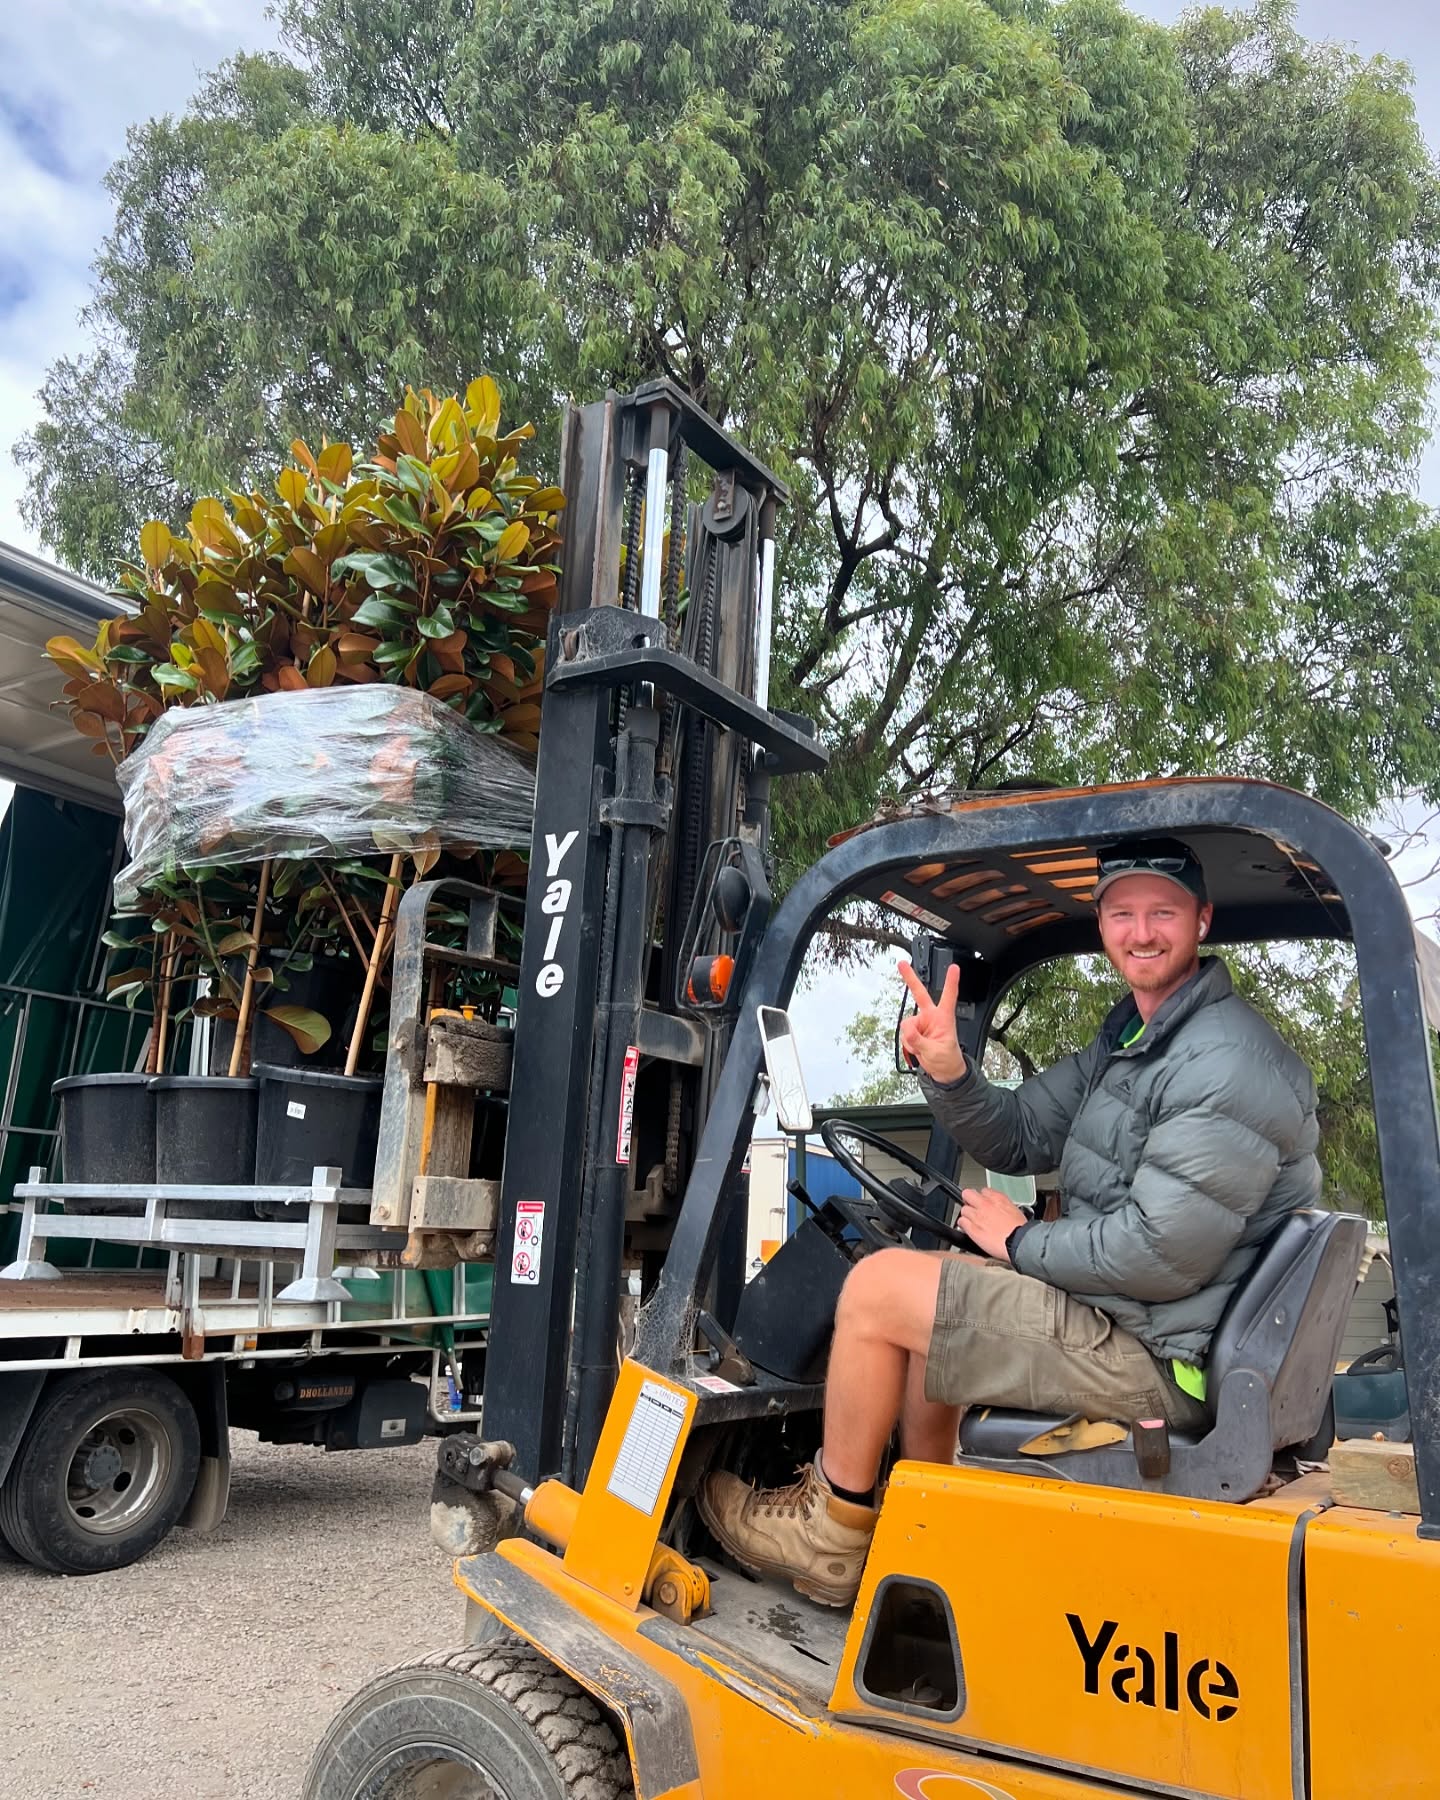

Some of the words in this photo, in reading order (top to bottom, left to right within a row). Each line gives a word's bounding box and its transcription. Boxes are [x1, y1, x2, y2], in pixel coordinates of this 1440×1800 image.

[535, 830, 580, 998] Yale
[300, 1385, 354, 1399] DHOLLANDIA
[1065, 1612, 1240, 1723] Yale
